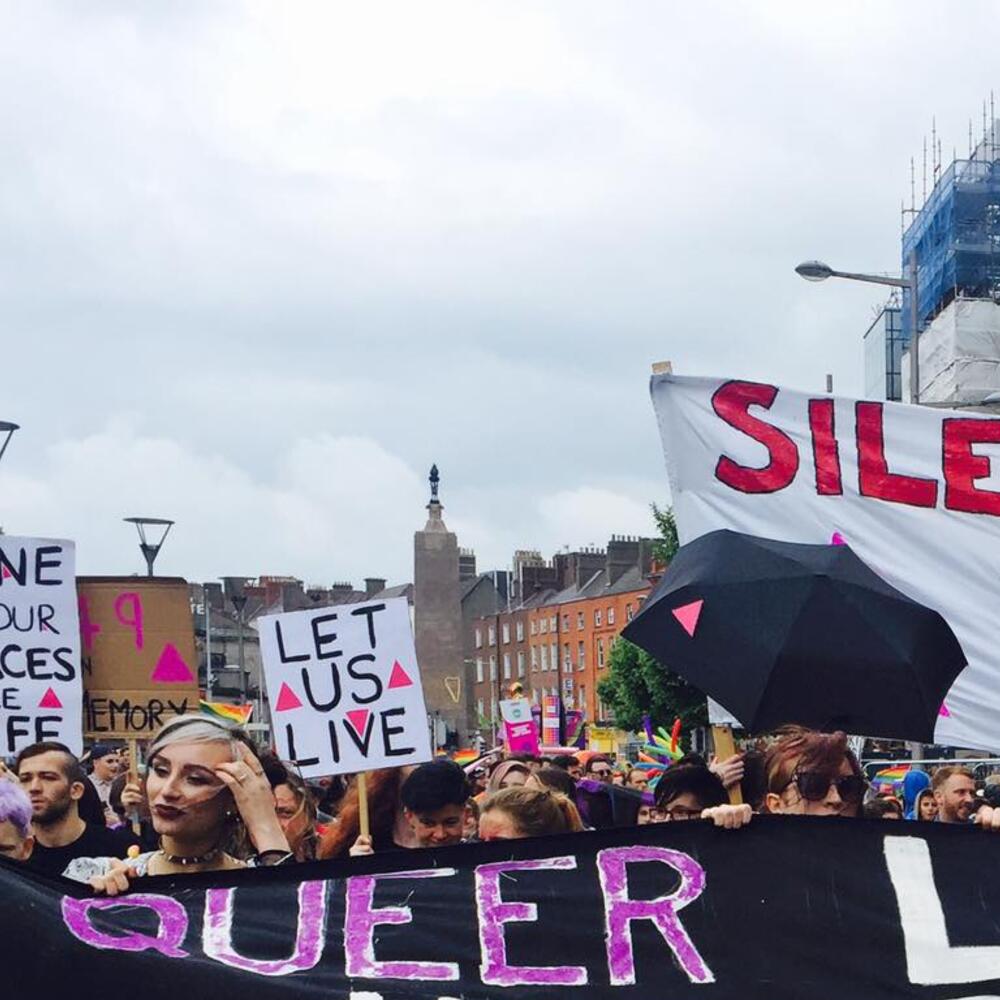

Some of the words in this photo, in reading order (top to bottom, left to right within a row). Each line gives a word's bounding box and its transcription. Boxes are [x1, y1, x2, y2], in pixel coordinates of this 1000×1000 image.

[275, 603, 386, 663] LET
[301, 653, 384, 713] US
[286, 707, 416, 767] LIVE
[61, 846, 715, 987] QUEER
